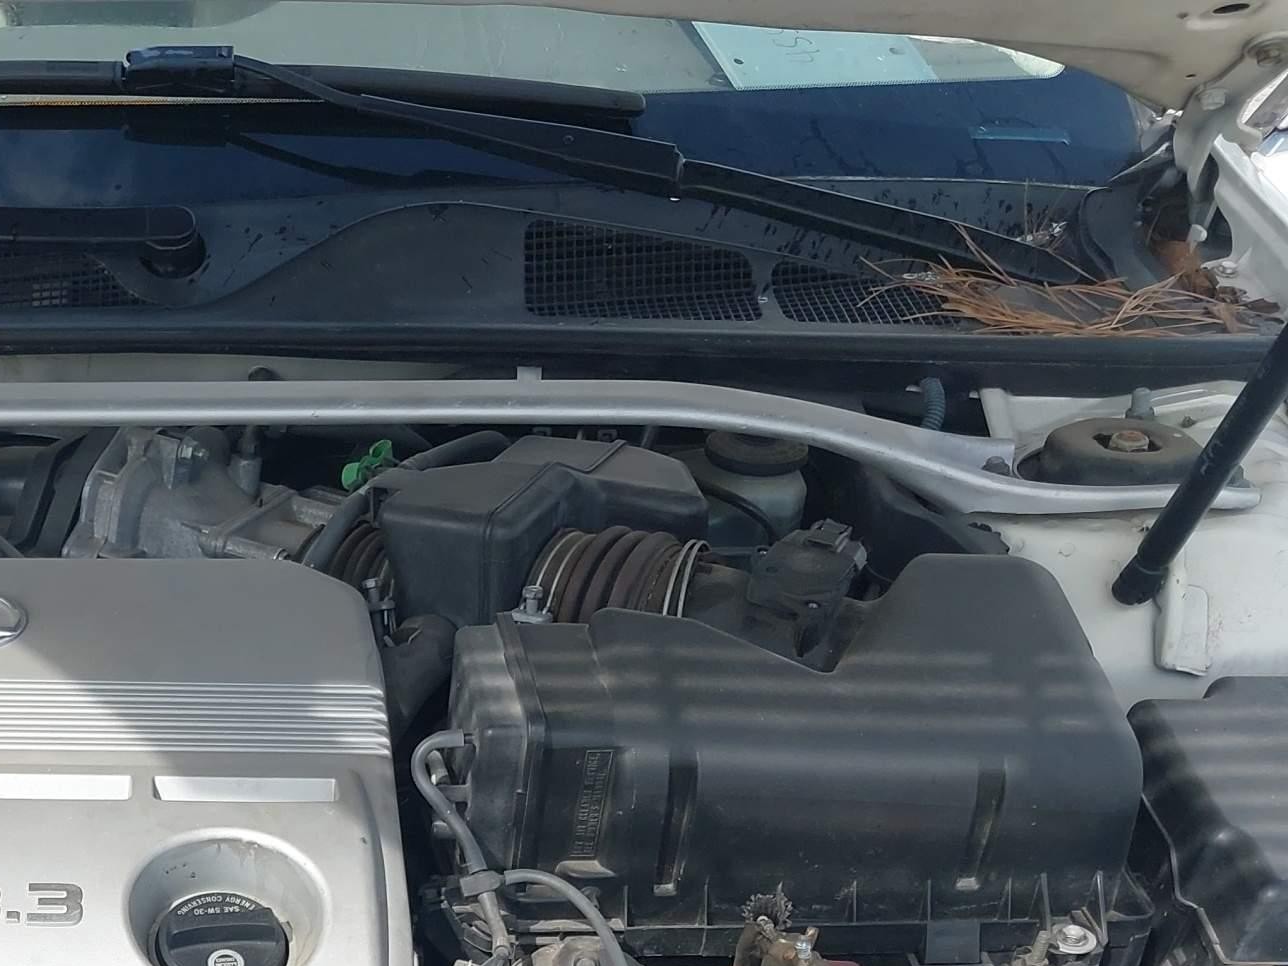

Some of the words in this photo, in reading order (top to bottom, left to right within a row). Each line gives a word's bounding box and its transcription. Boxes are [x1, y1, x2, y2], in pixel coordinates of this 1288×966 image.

[177, 895, 223, 916] CONSERVING
[193, 906, 220, 915] 5W-30
[224, 895, 256, 911] ENERGY
